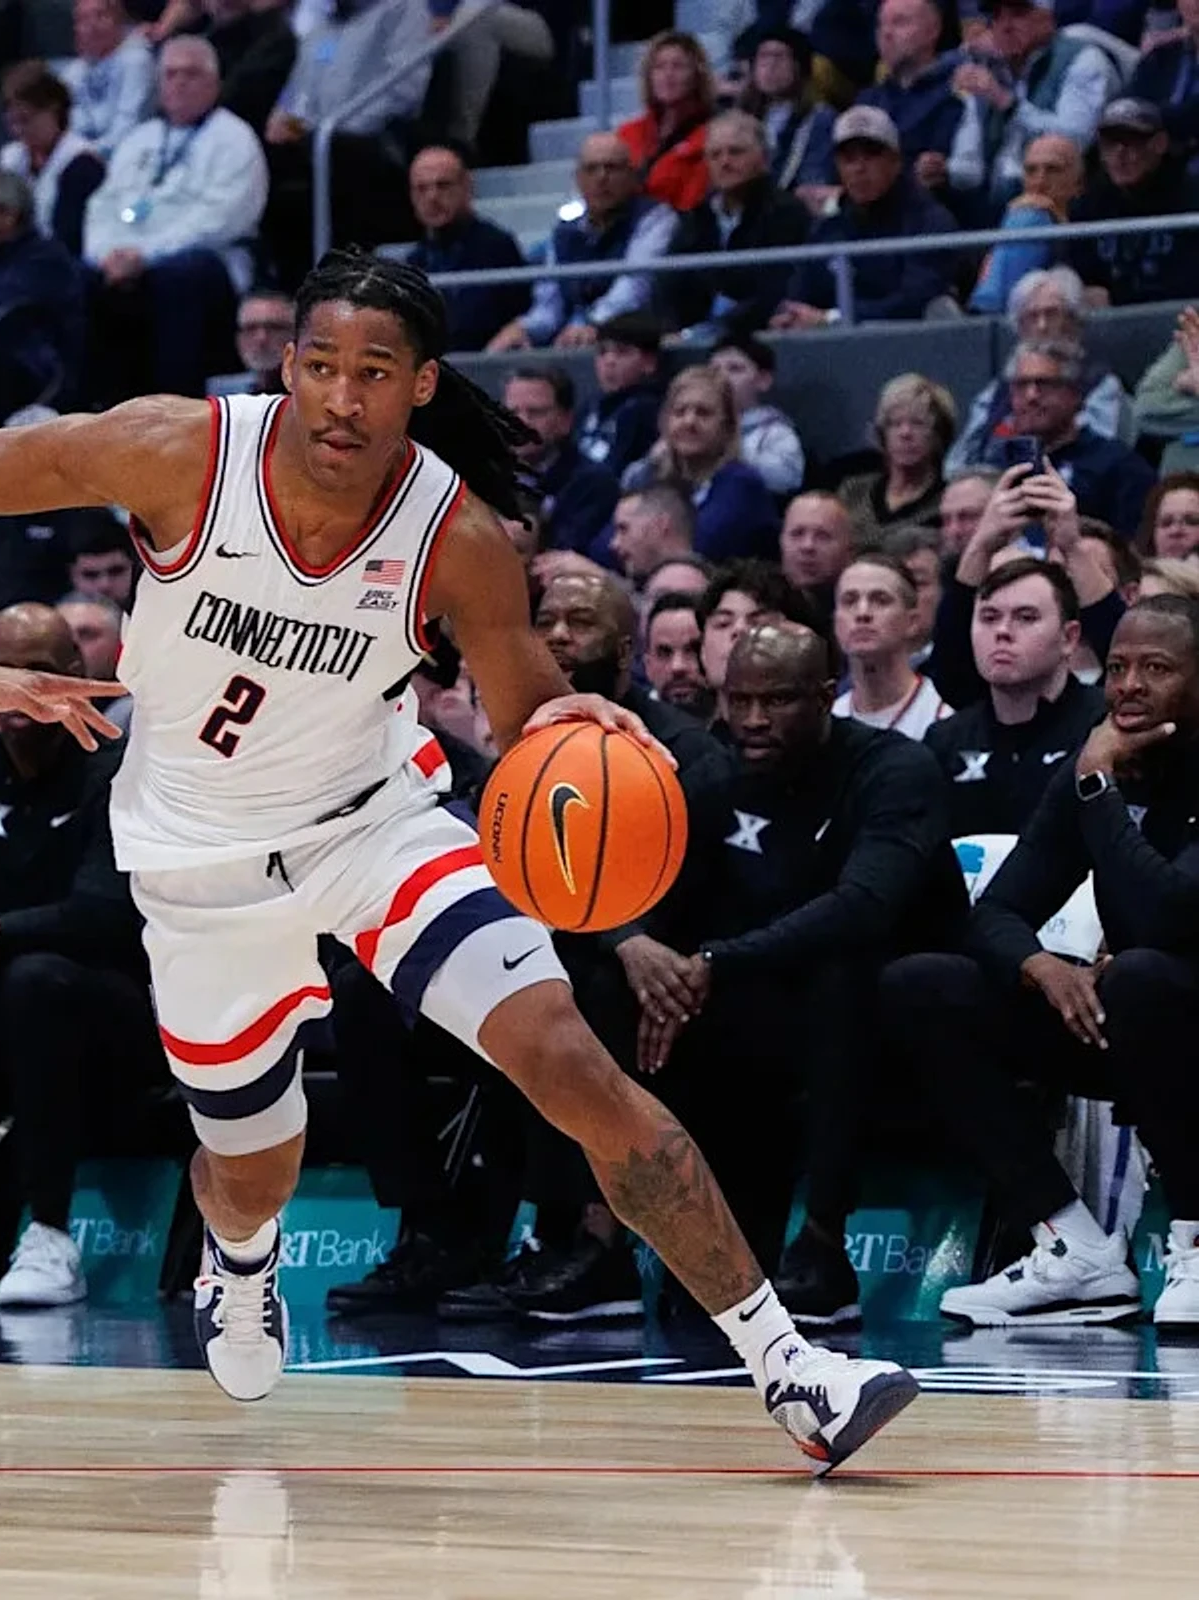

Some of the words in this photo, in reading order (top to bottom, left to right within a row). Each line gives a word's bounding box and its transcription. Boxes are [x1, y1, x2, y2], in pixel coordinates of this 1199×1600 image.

[184, 590, 378, 682] CONNECTICUT
[198, 673, 267, 759] 2
[492, 792, 509, 863] UCONN
[317, 1229, 387, 1268] Bank
